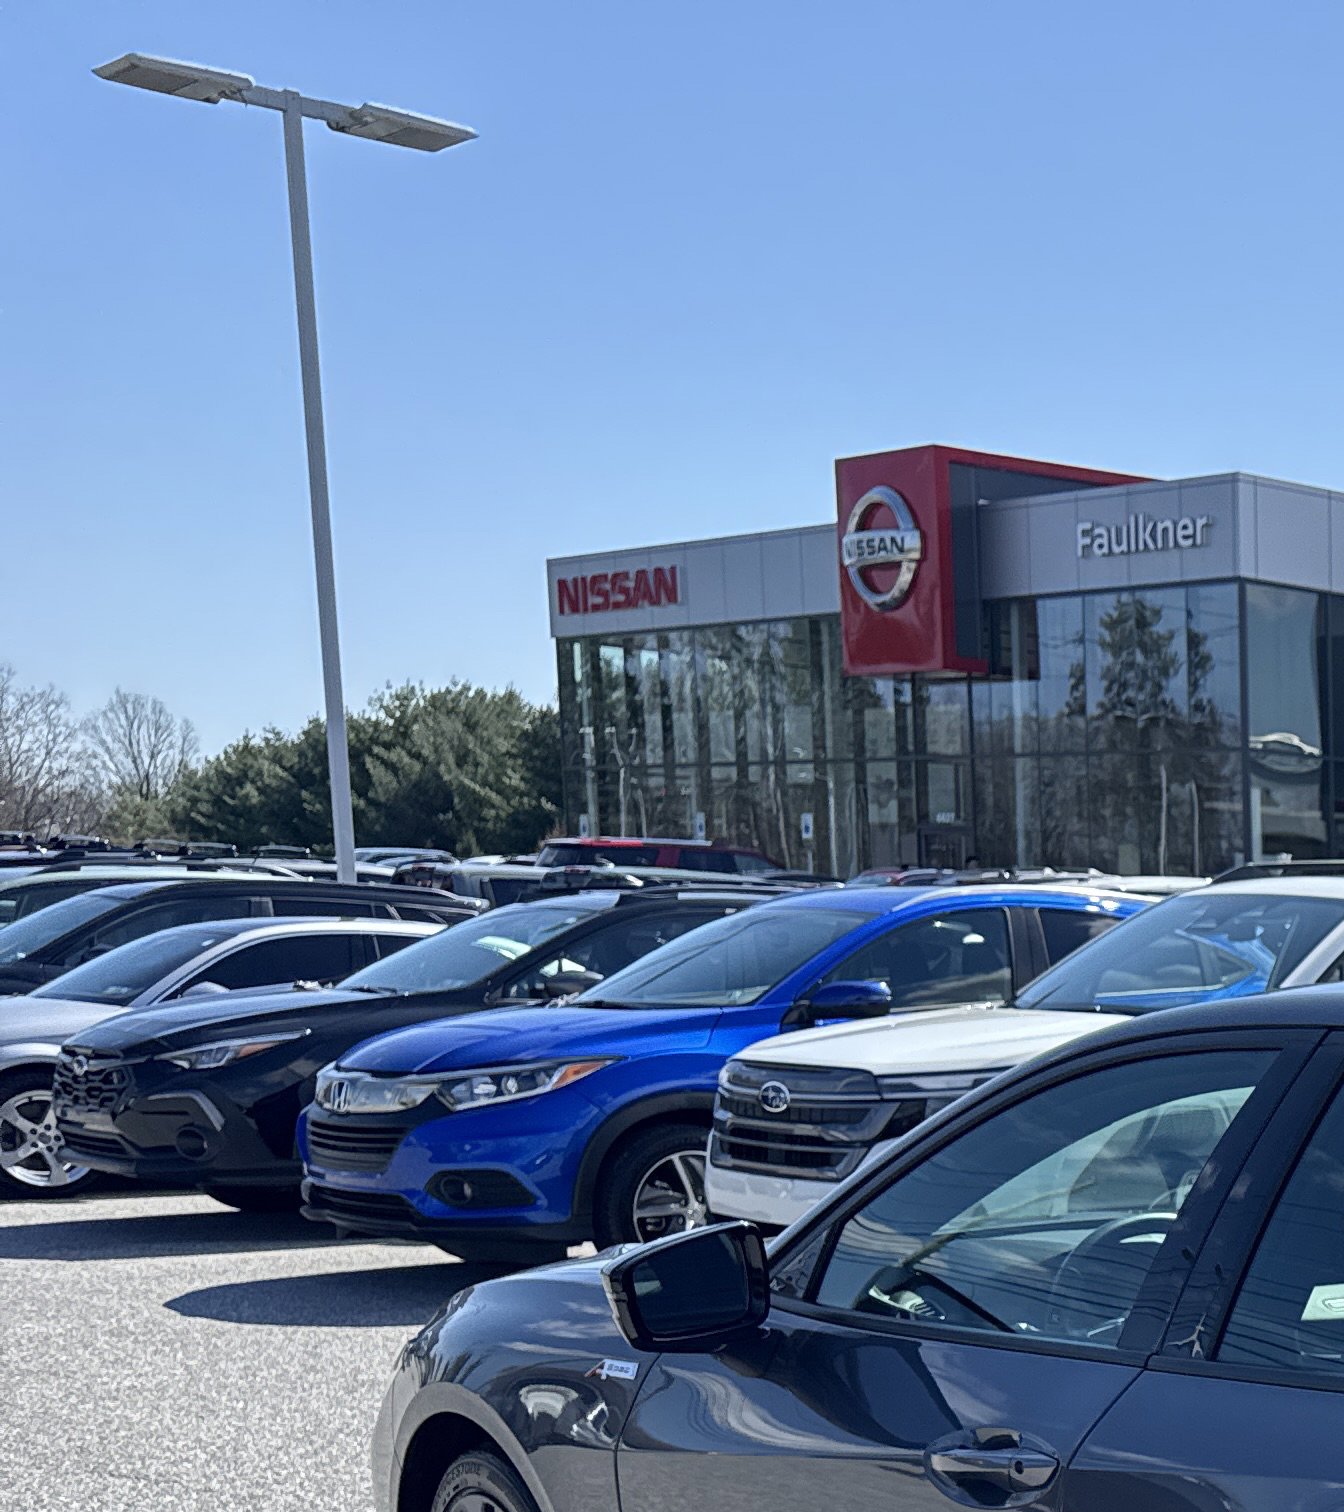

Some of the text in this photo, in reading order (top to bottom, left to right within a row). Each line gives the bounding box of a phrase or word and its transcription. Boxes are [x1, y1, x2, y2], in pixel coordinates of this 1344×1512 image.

[846, 535, 905, 558] NISSAN
[1077, 513, 1208, 558] Faulkner
[557, 564, 679, 616] NISSAN
